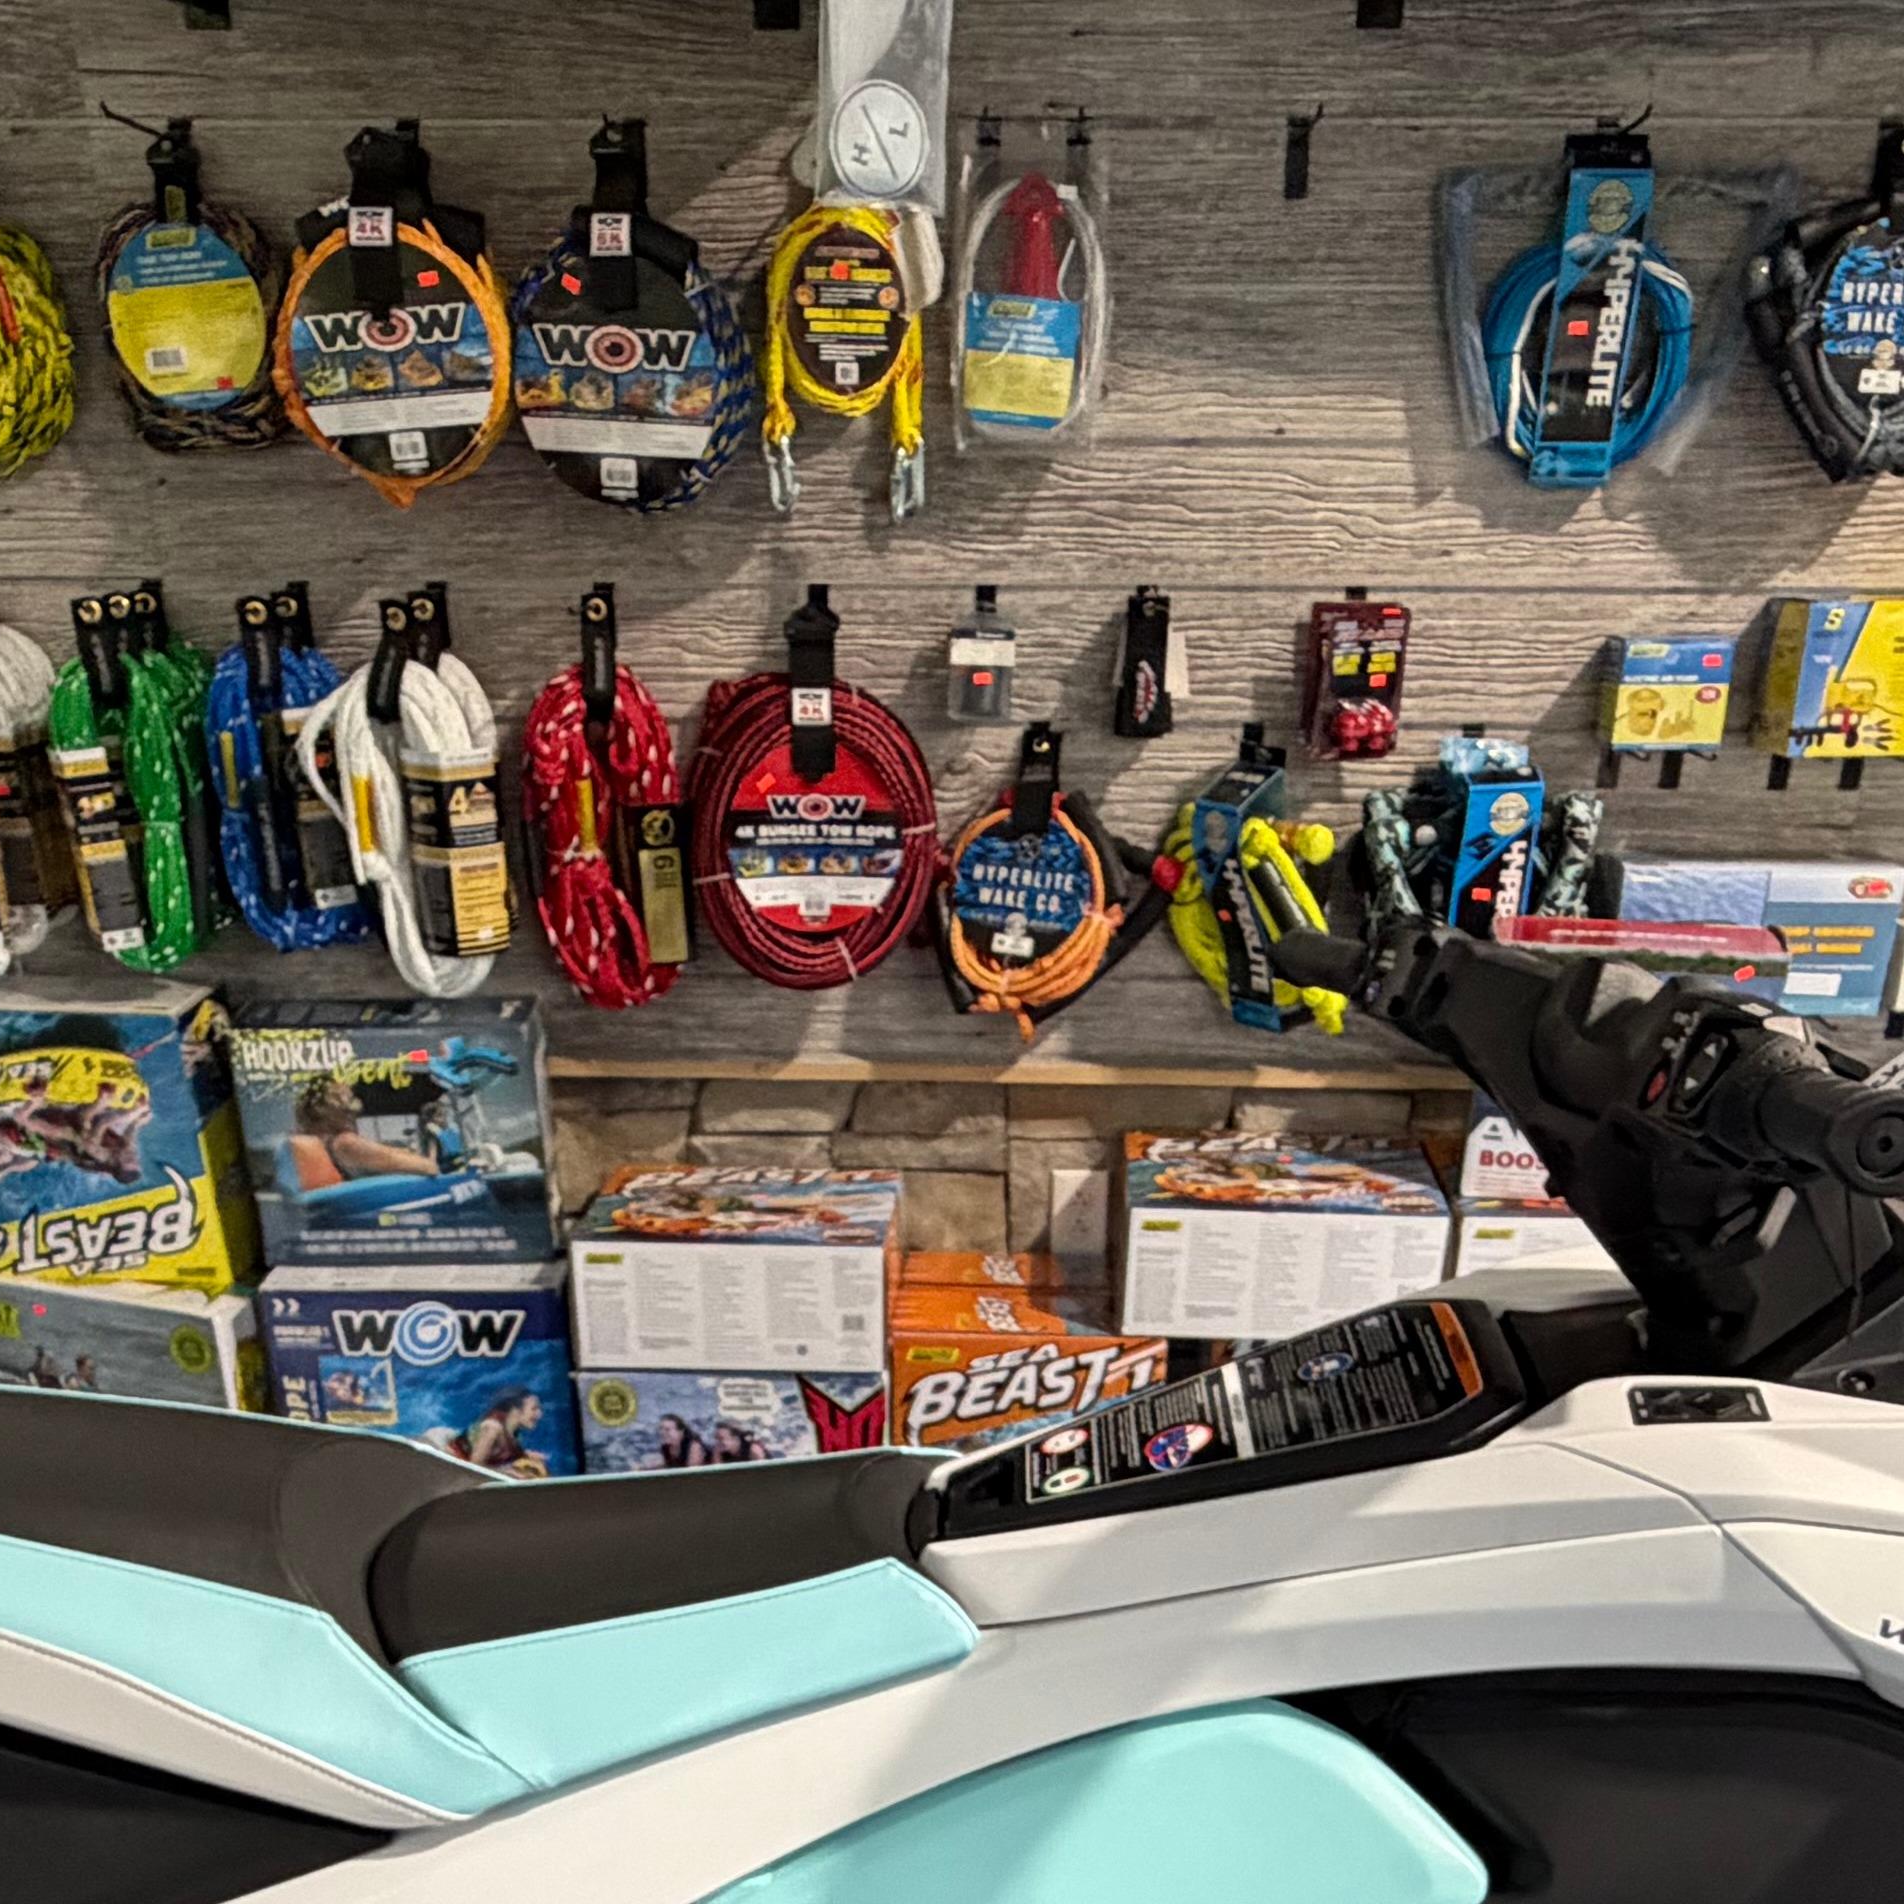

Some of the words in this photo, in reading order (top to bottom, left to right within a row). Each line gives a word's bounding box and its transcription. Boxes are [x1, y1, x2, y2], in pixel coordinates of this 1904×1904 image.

[304, 303, 466, 352] WOW
[1585, 238, 1641, 408] HYPERLITE
[1846, 310, 1897, 334] WAKE
[533, 323, 695, 373] WOW
[767, 793, 866, 821] WOW
[971, 863, 1075, 893] HYPERLITE
[978, 886, 1028, 909] WAKE
[1223, 858, 1272, 993] HYPERLITE
[241, 1038, 355, 1071] HOOKZUP
[16, 1199, 200, 1274] BEAST
[330, 1300, 527, 1366] WOW
[968, 1342, 1061, 1372] SEA
[906, 1345, 1121, 1448] BEAST
